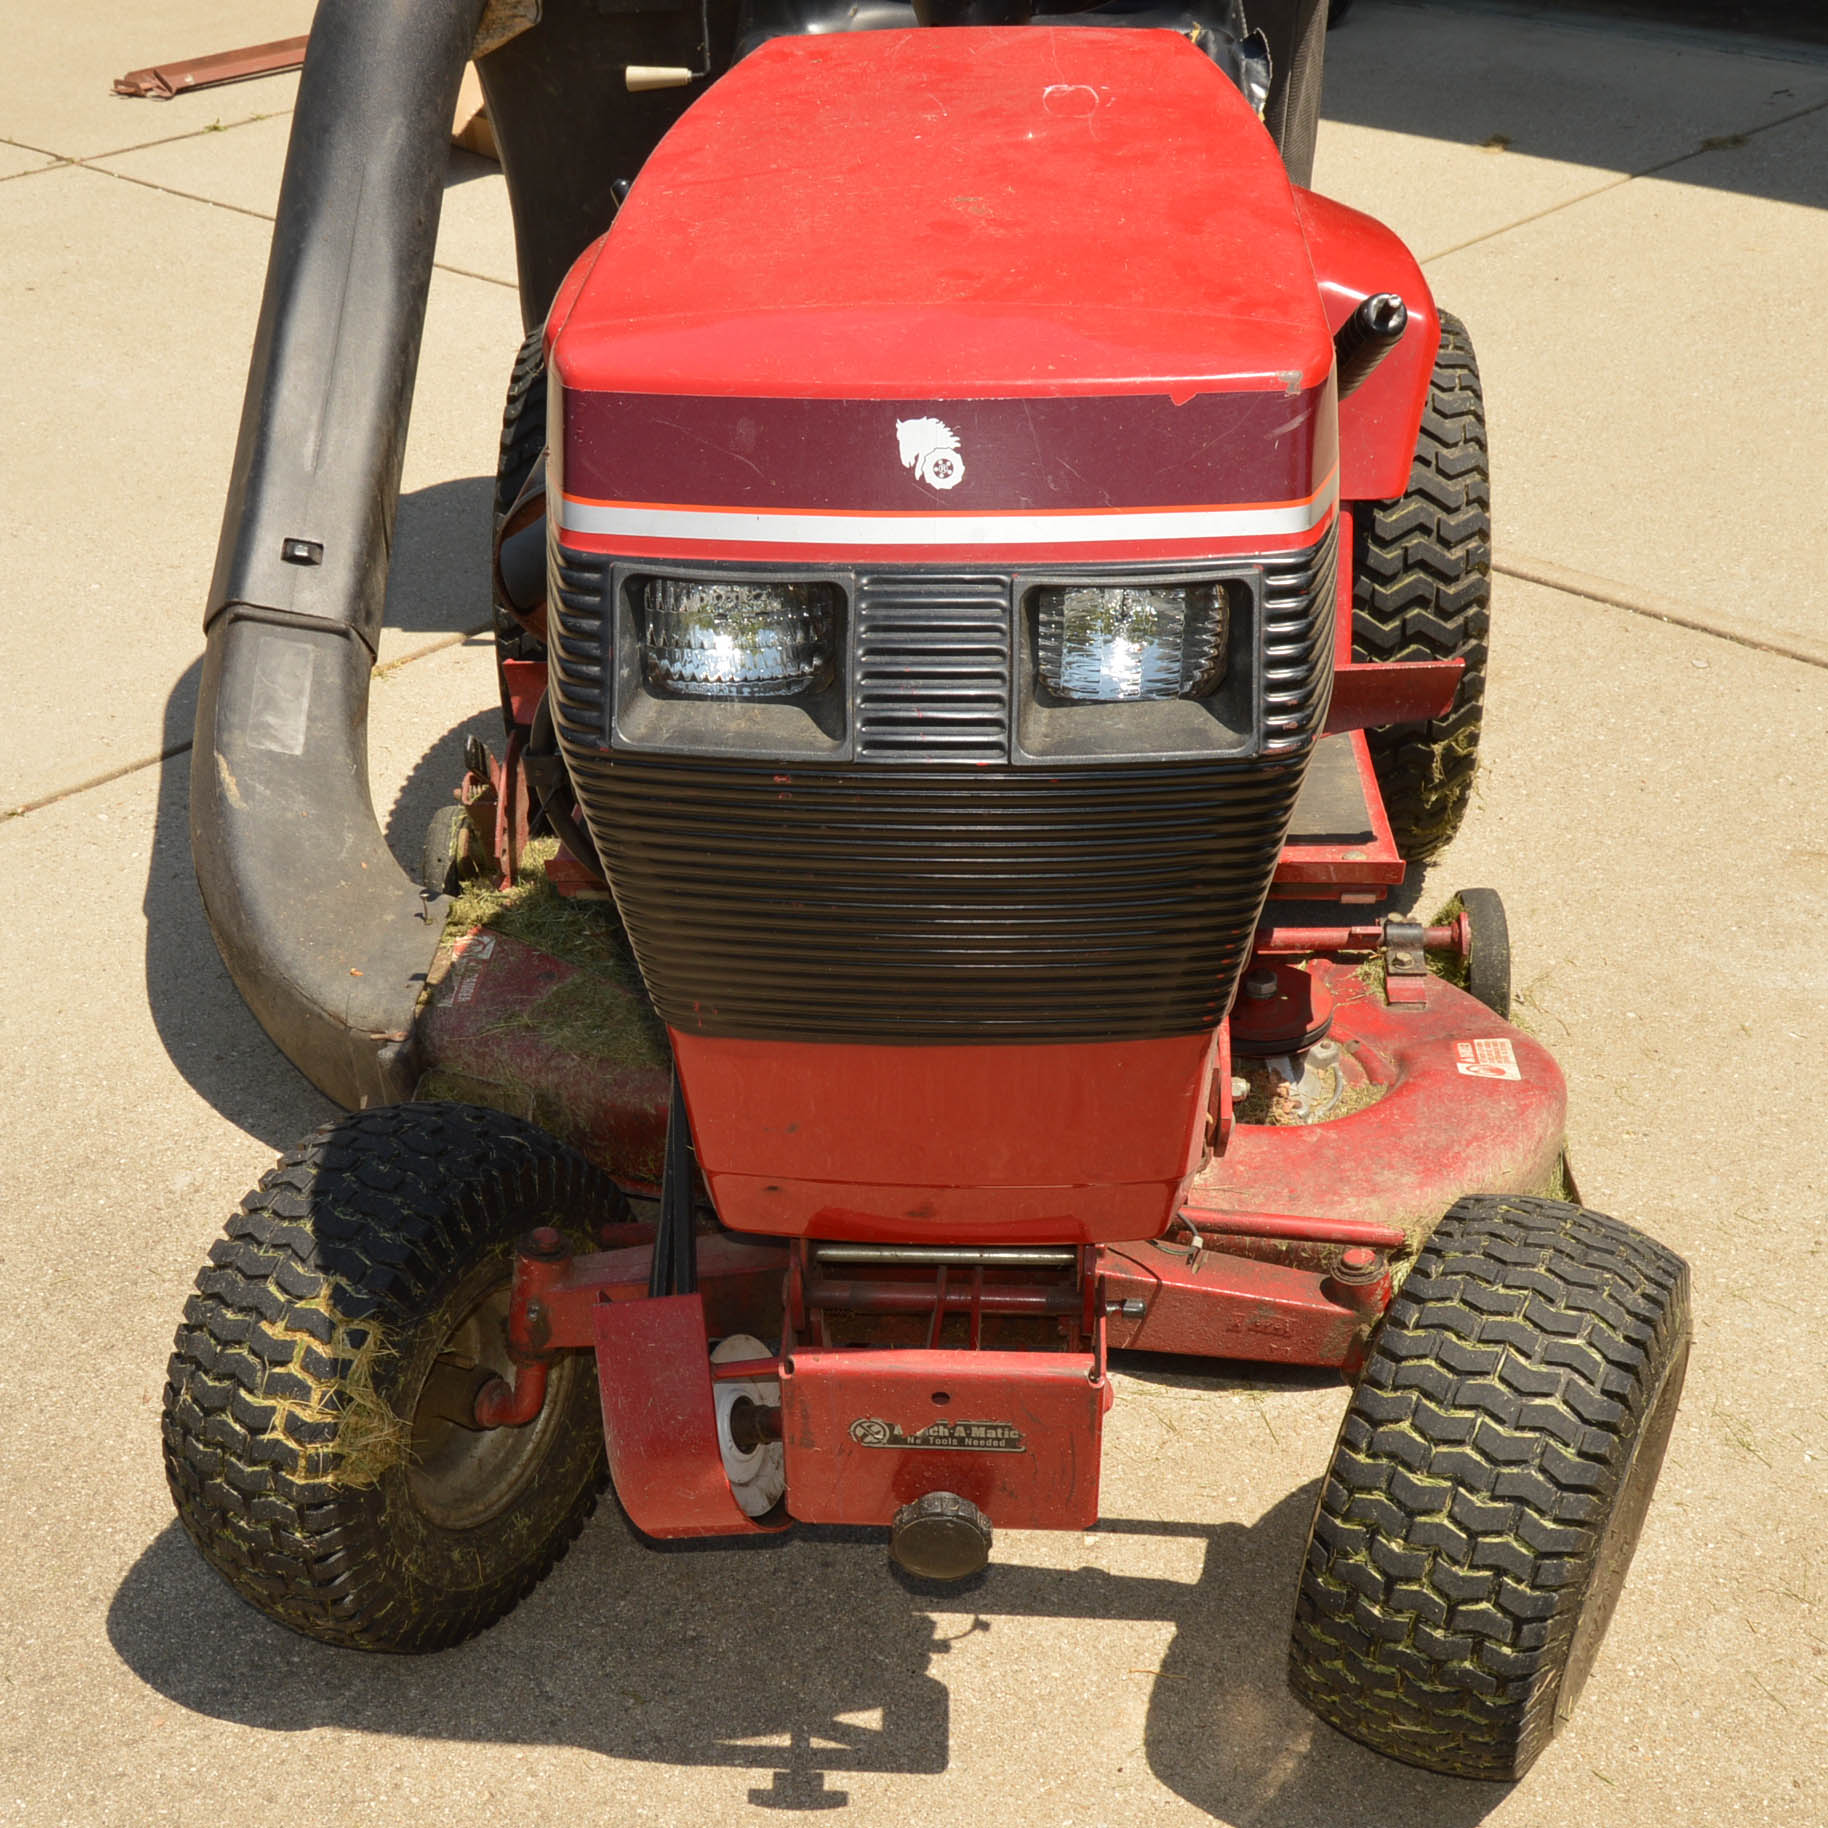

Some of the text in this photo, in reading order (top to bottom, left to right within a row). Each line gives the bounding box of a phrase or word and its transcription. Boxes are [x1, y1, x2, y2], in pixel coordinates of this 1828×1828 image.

[893, 1424, 1020, 1438] Ach-A-Matic
[928, 1436, 958, 1446] Tools
[965, 1437, 1006, 1447] Needed
